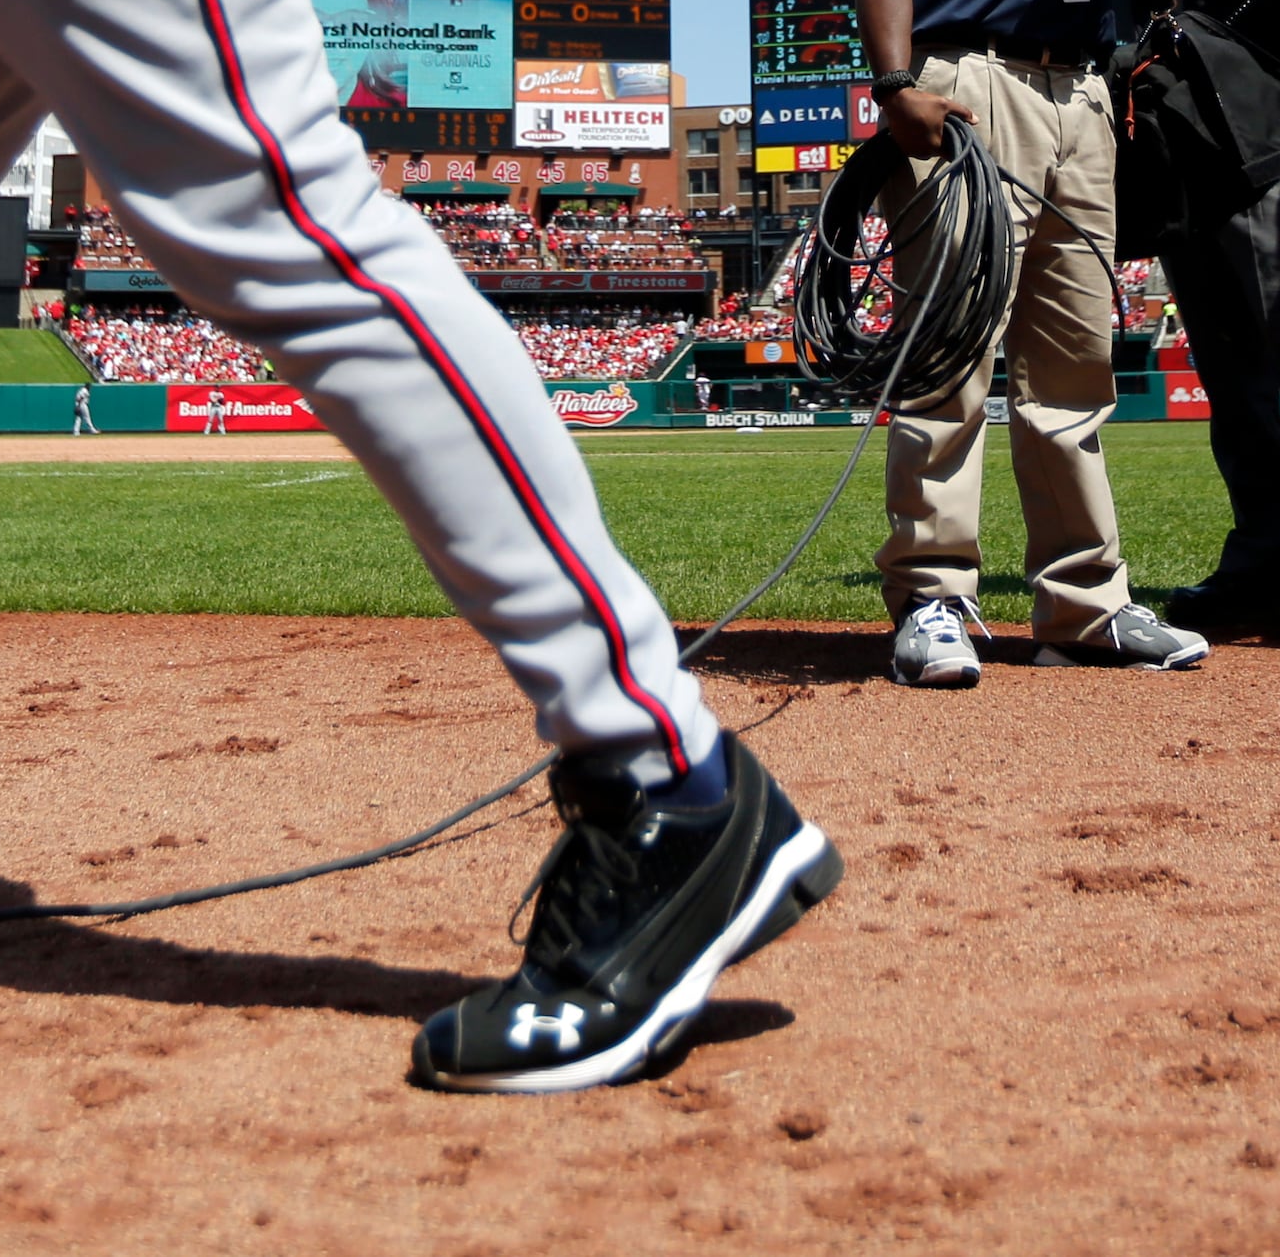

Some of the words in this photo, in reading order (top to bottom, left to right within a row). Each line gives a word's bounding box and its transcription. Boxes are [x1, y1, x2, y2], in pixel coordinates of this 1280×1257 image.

[520, 2, 538, 21] 0
[571, 3, 589, 22] 0
[631, 4, 641, 23] 1
[775, 2, 784, 13] 4
[775, 17, 784, 29] 3
[352, 23, 439, 38] National
[443, 24, 496, 40] Bank
[776, 31, 784, 43] 5
[776, 46, 785, 58] 3
[776, 60, 785, 72] 4
[787, 74, 823, 84] Murphy
[564, 110, 664, 125] HELITECH
[780, 107, 843, 122] DELTA
[404, 161, 431, 182] 20
[447, 161, 475, 183] 24
[493, 161, 521, 183] 42
[536, 161, 565, 183] 45
[580, 161, 609, 183] 85
[608, 275, 687, 289] Firestone
[233, 401, 293, 416] America
[706, 414, 751, 426] BUSCH
[755, 413, 815, 426] STADIUM
[851, 413, 873, 424] 375
